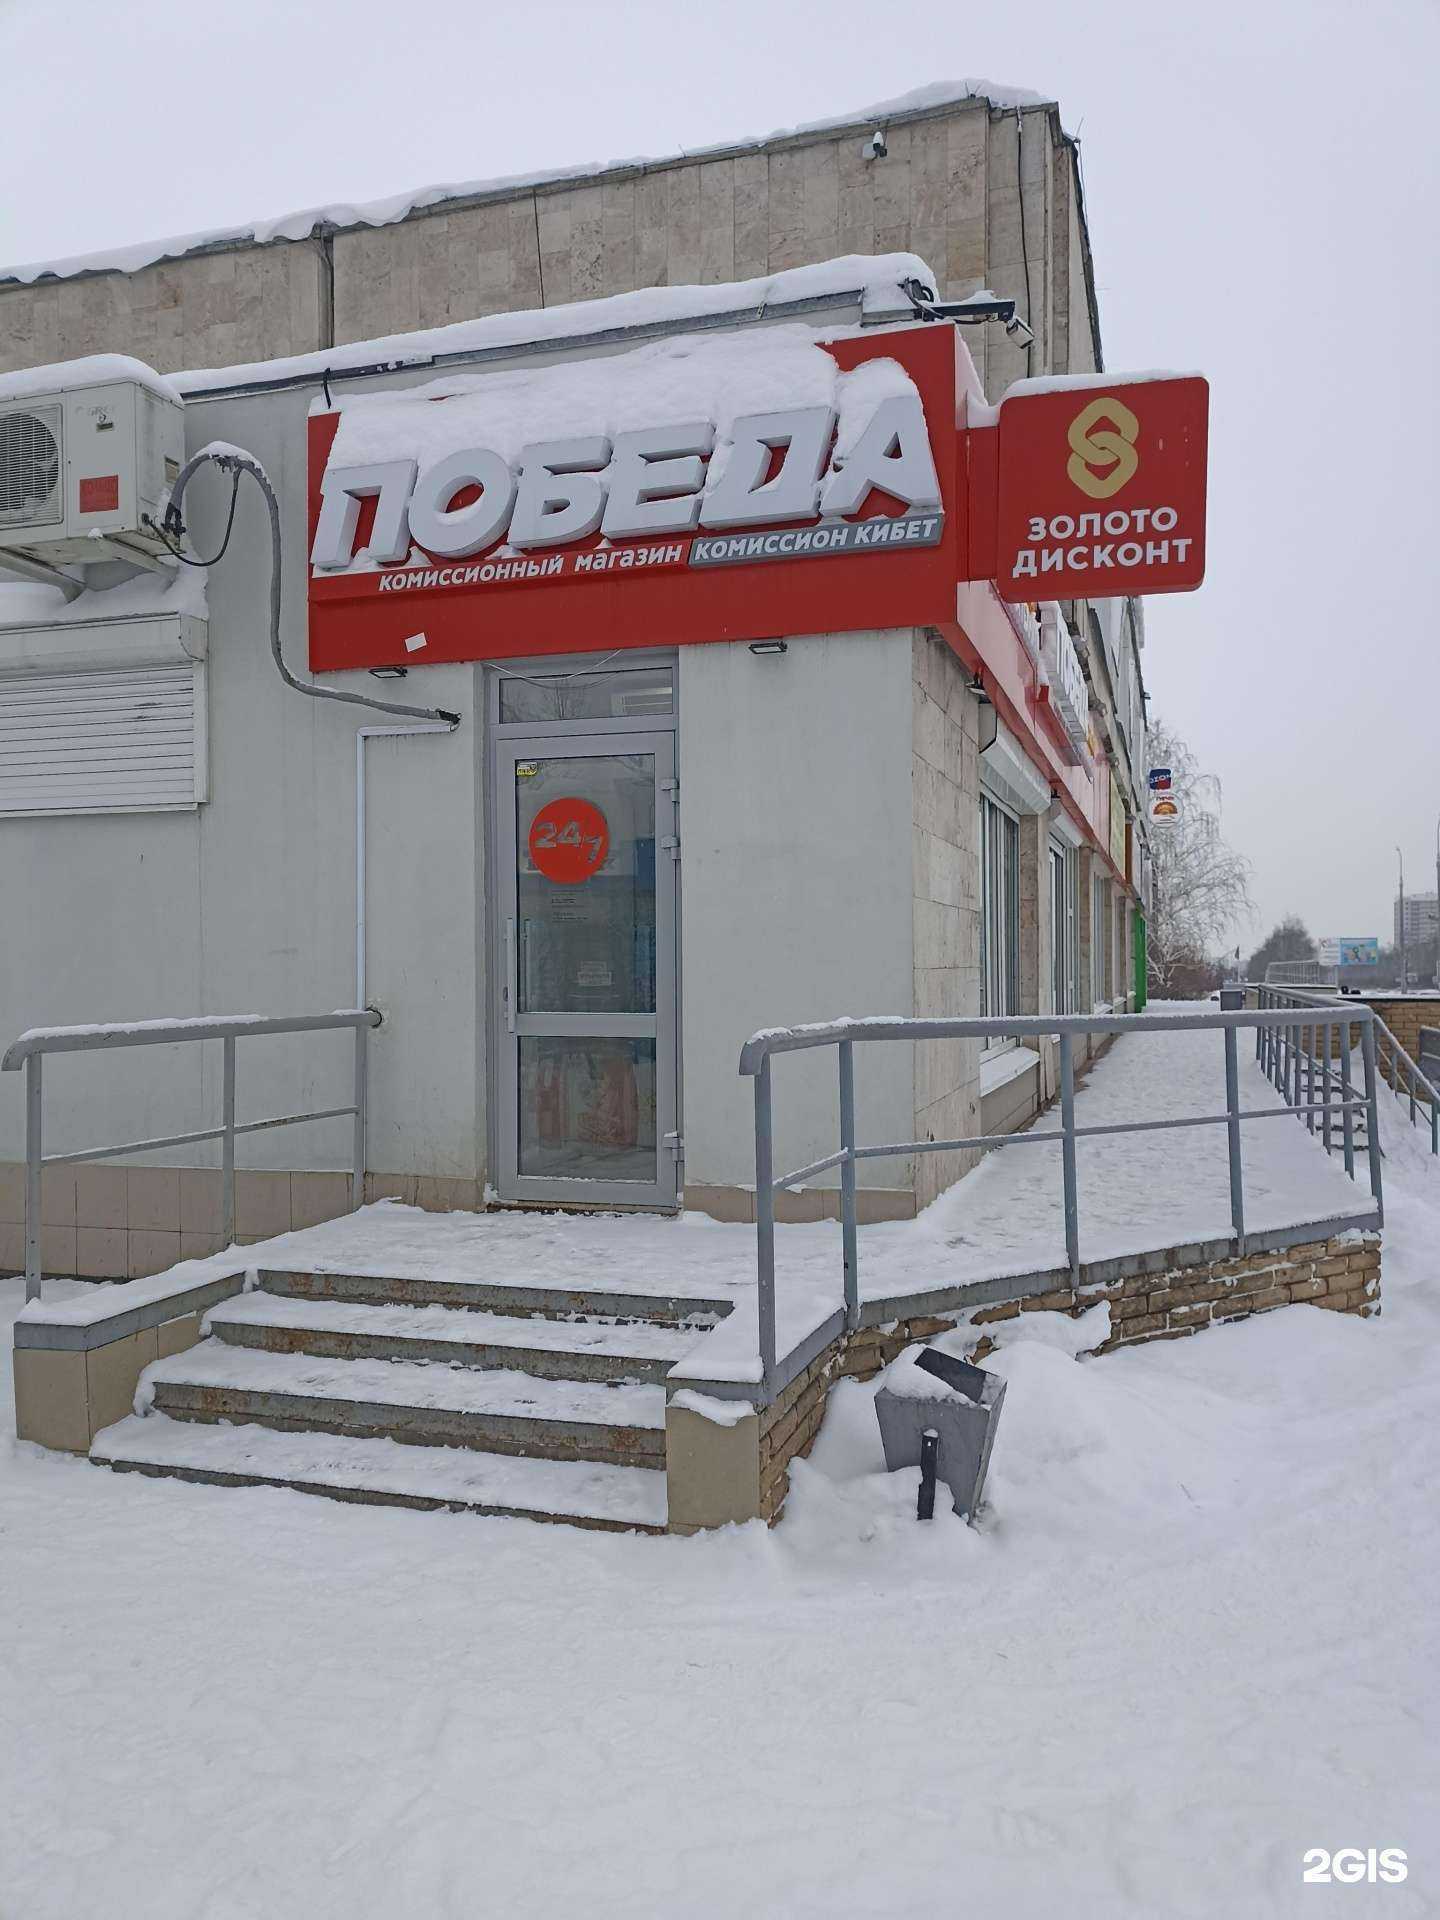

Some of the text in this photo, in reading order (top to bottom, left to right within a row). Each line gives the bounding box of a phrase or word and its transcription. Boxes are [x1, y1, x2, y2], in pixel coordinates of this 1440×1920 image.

[310, 395, 943, 571] ПОБЕДА
[694, 518, 938, 560] КОМИССИОН КИБЕТ
[1027, 506, 1178, 542] ЗОЛОТО
[575, 544, 683, 572] магазин
[1012, 538, 1192, 579] ДИСКОНТ
